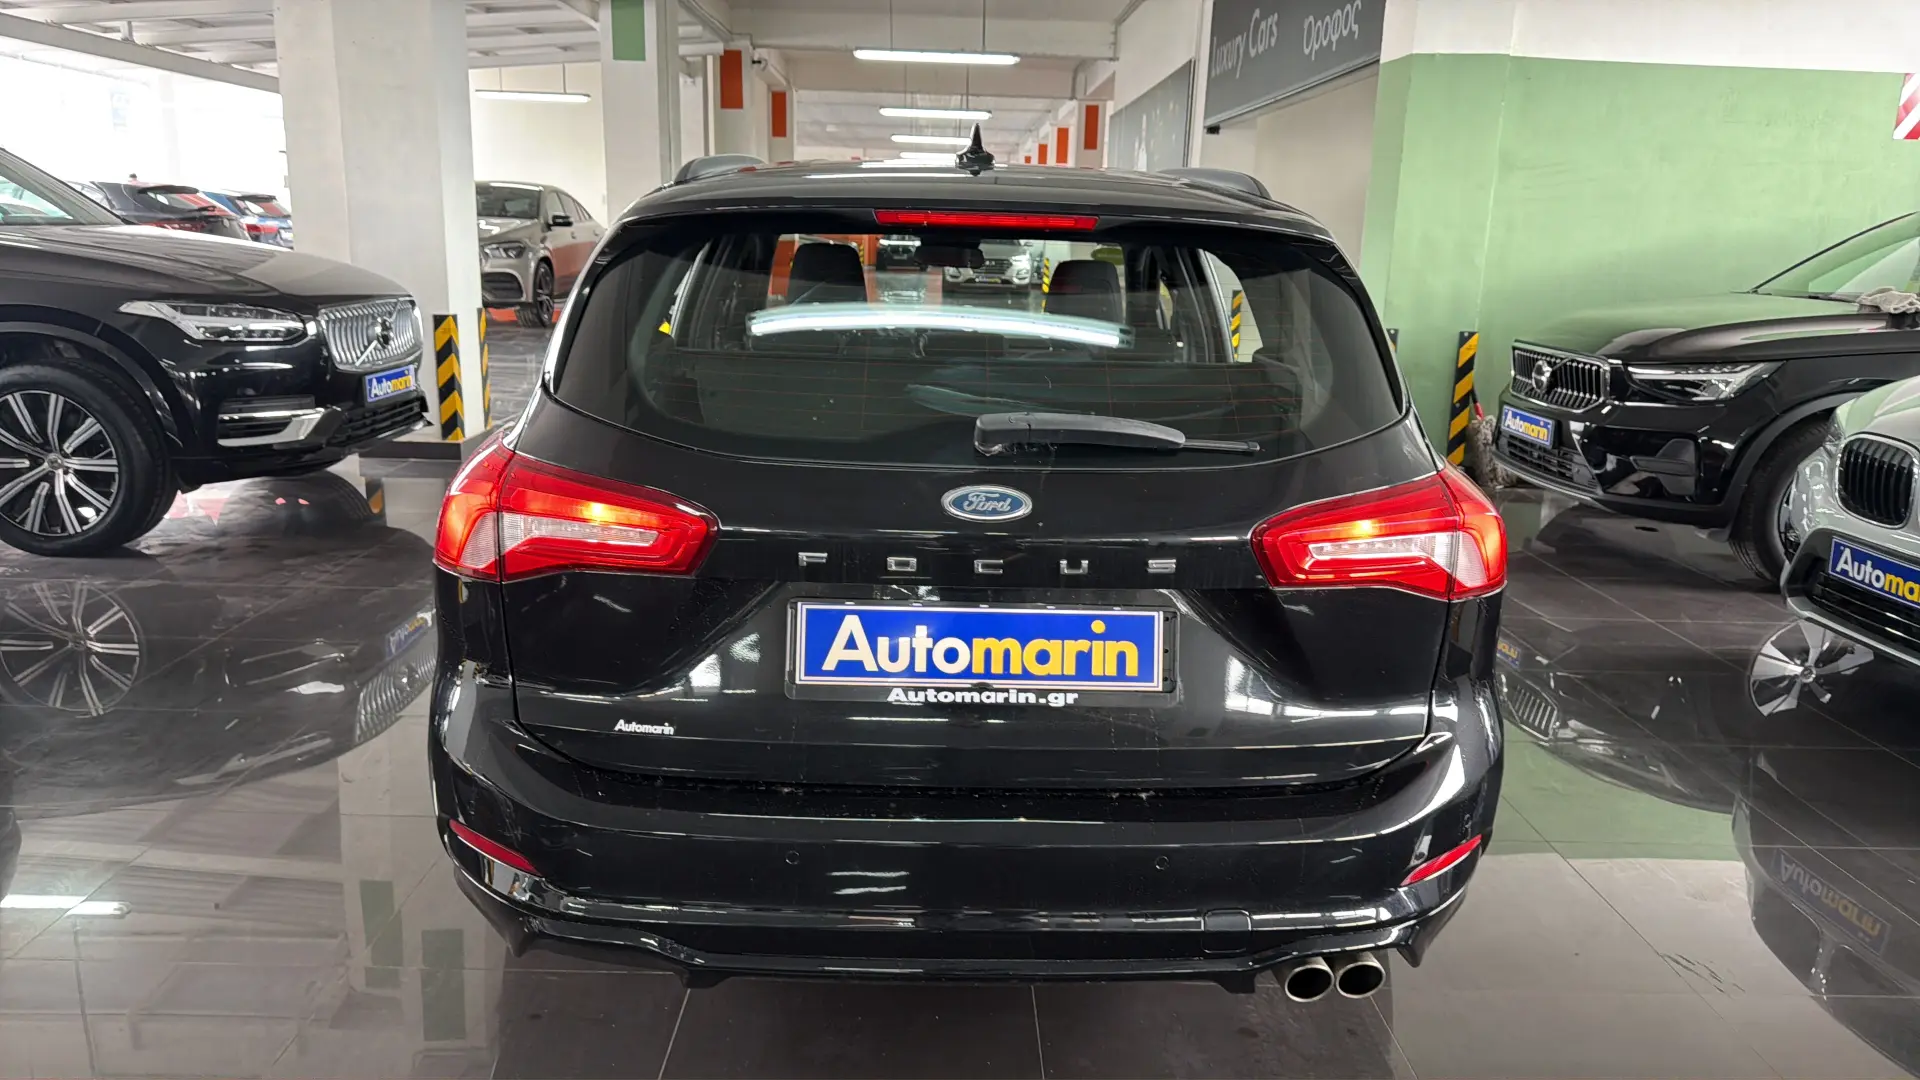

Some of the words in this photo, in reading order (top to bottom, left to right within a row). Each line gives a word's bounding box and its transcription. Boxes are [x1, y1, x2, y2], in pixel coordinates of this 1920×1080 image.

[1211, 32, 1247, 79] Luxury
[1249, 8, 1278, 58] Cars
[370, 369, 412, 398] Automarin
[1504, 410, 1548, 440] Automarin
[963, 492, 1012, 511] Ford
[798, 551, 1177, 574] FOCUS
[821, 614, 1139, 677] Automarin
[887, 687, 1079, 707] Automarin.gr
[614, 719, 674, 735] Automarin
